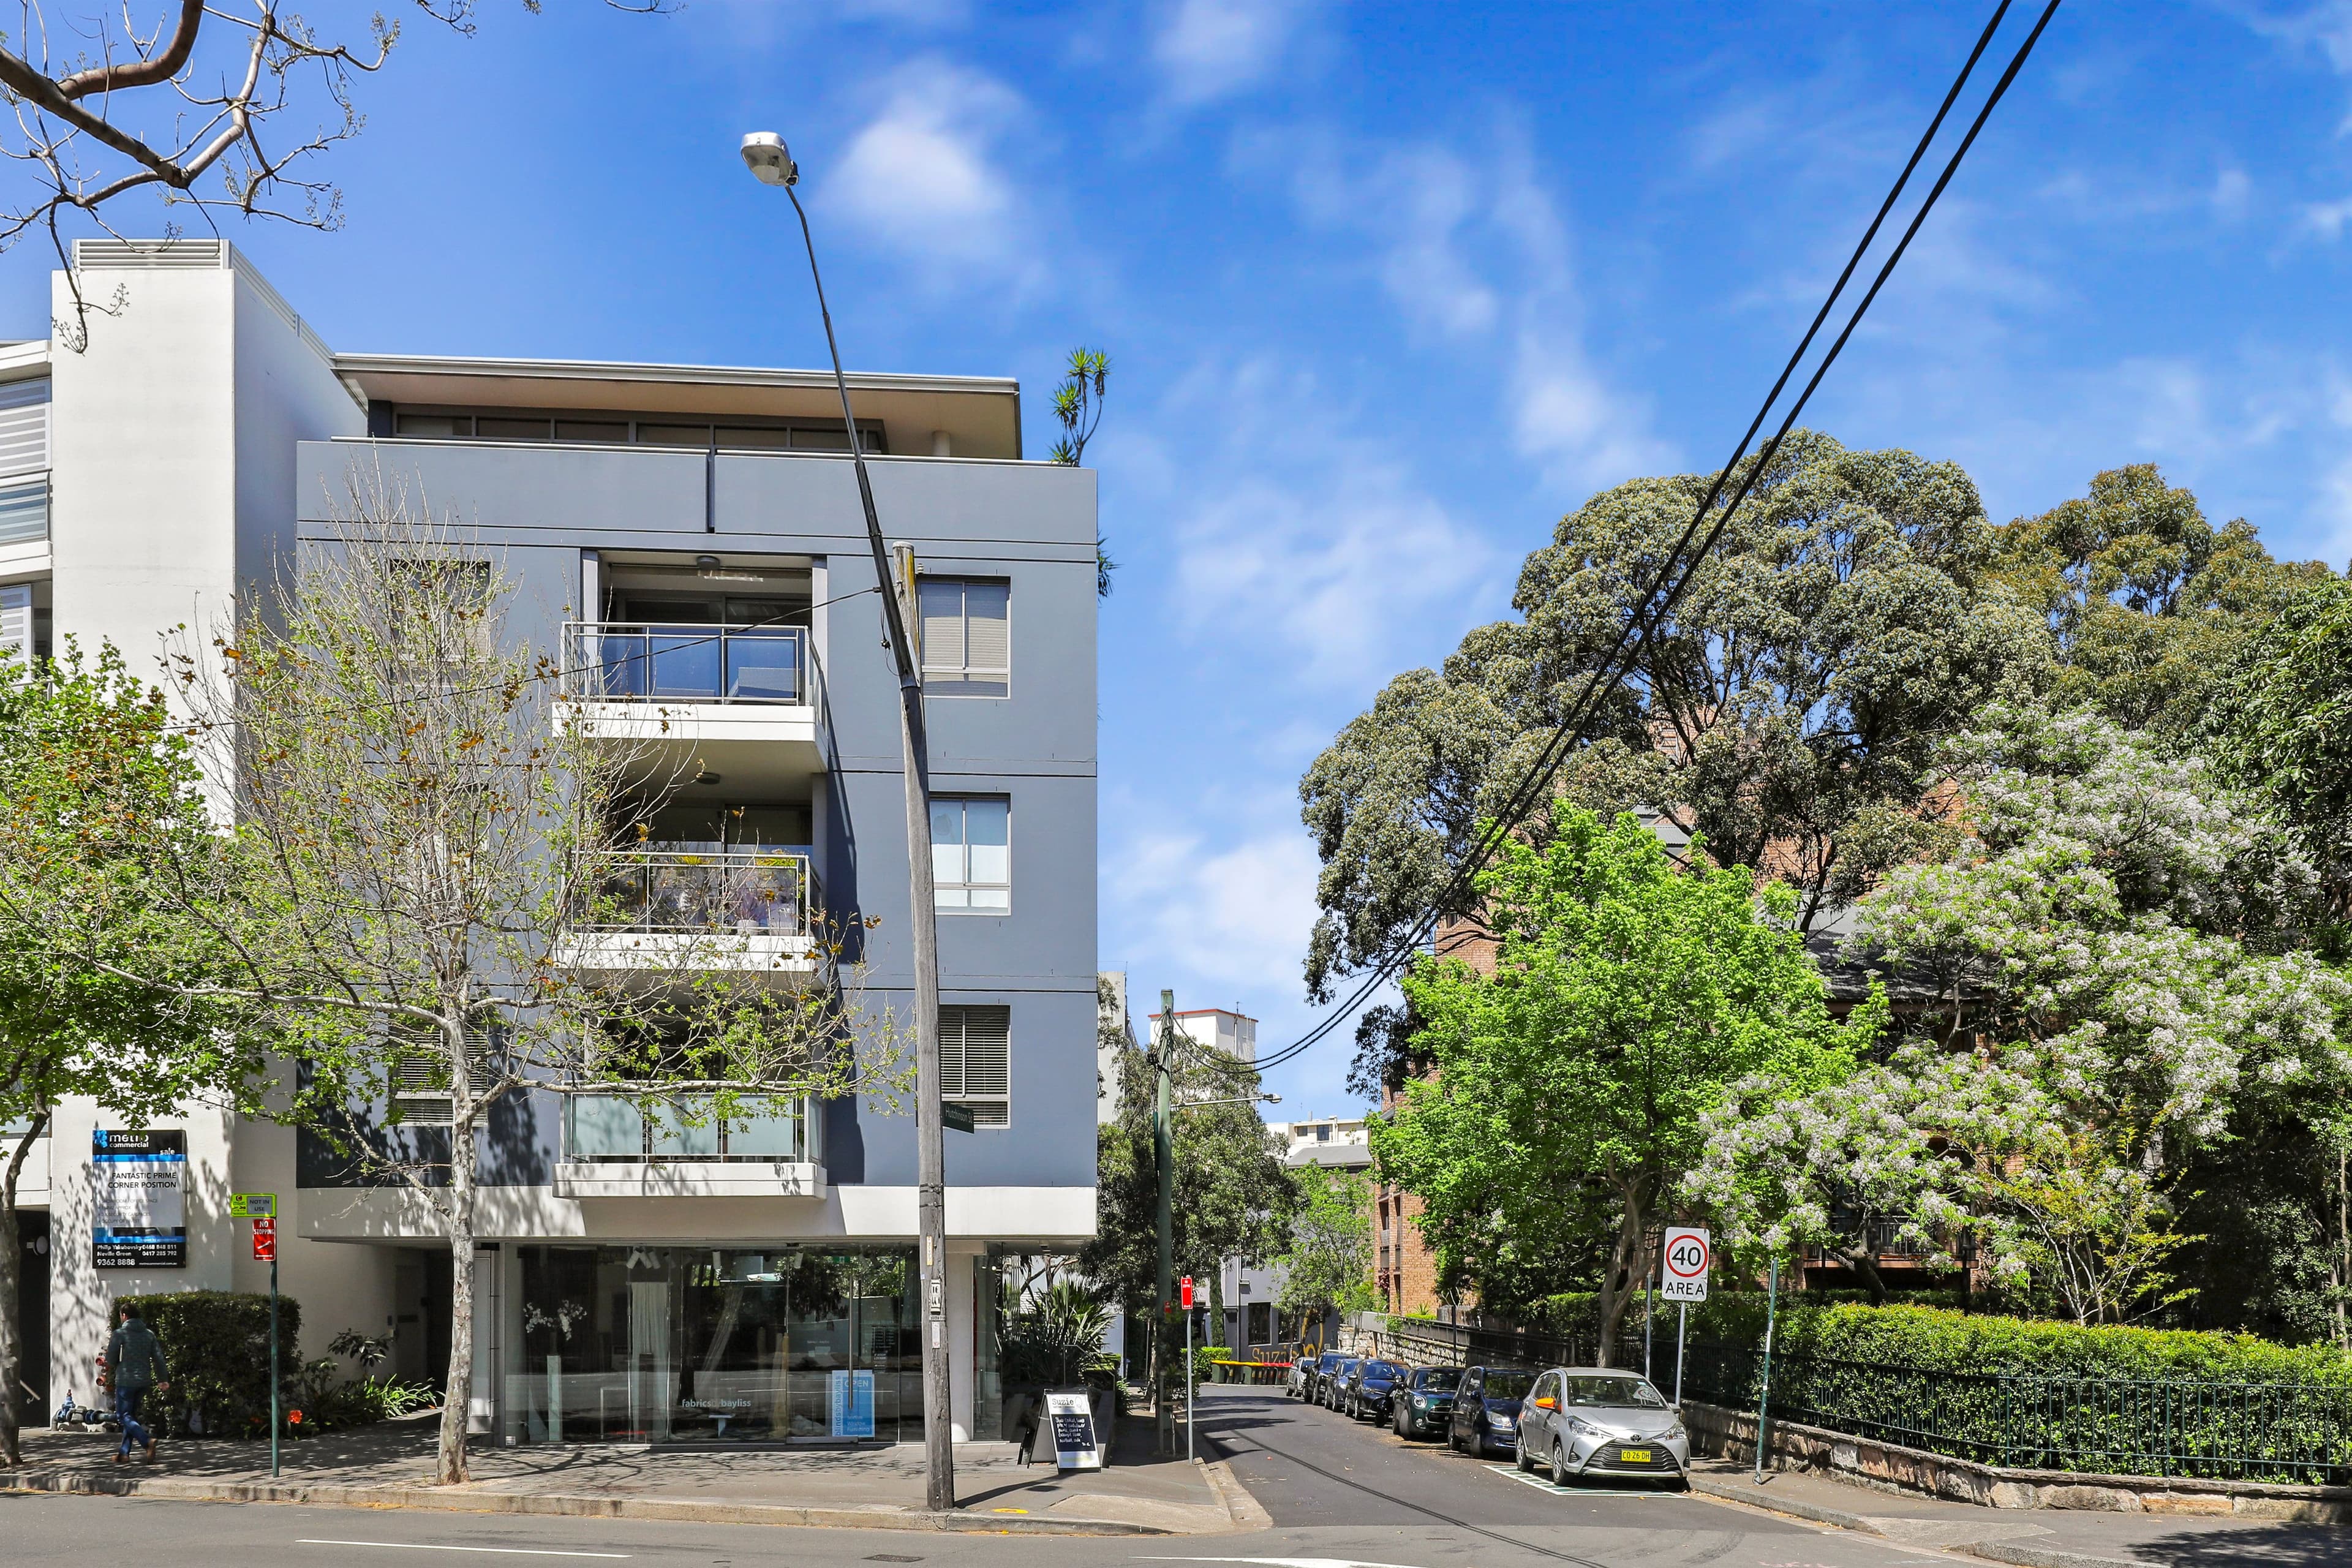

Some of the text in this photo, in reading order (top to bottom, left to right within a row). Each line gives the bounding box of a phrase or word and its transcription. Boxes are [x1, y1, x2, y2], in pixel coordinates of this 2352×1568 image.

[1672, 1246, 1701, 1266] 40
[1665, 1282, 1705, 1295] AREA
[682, 1398, 752, 1409] fabricsbbayliss
